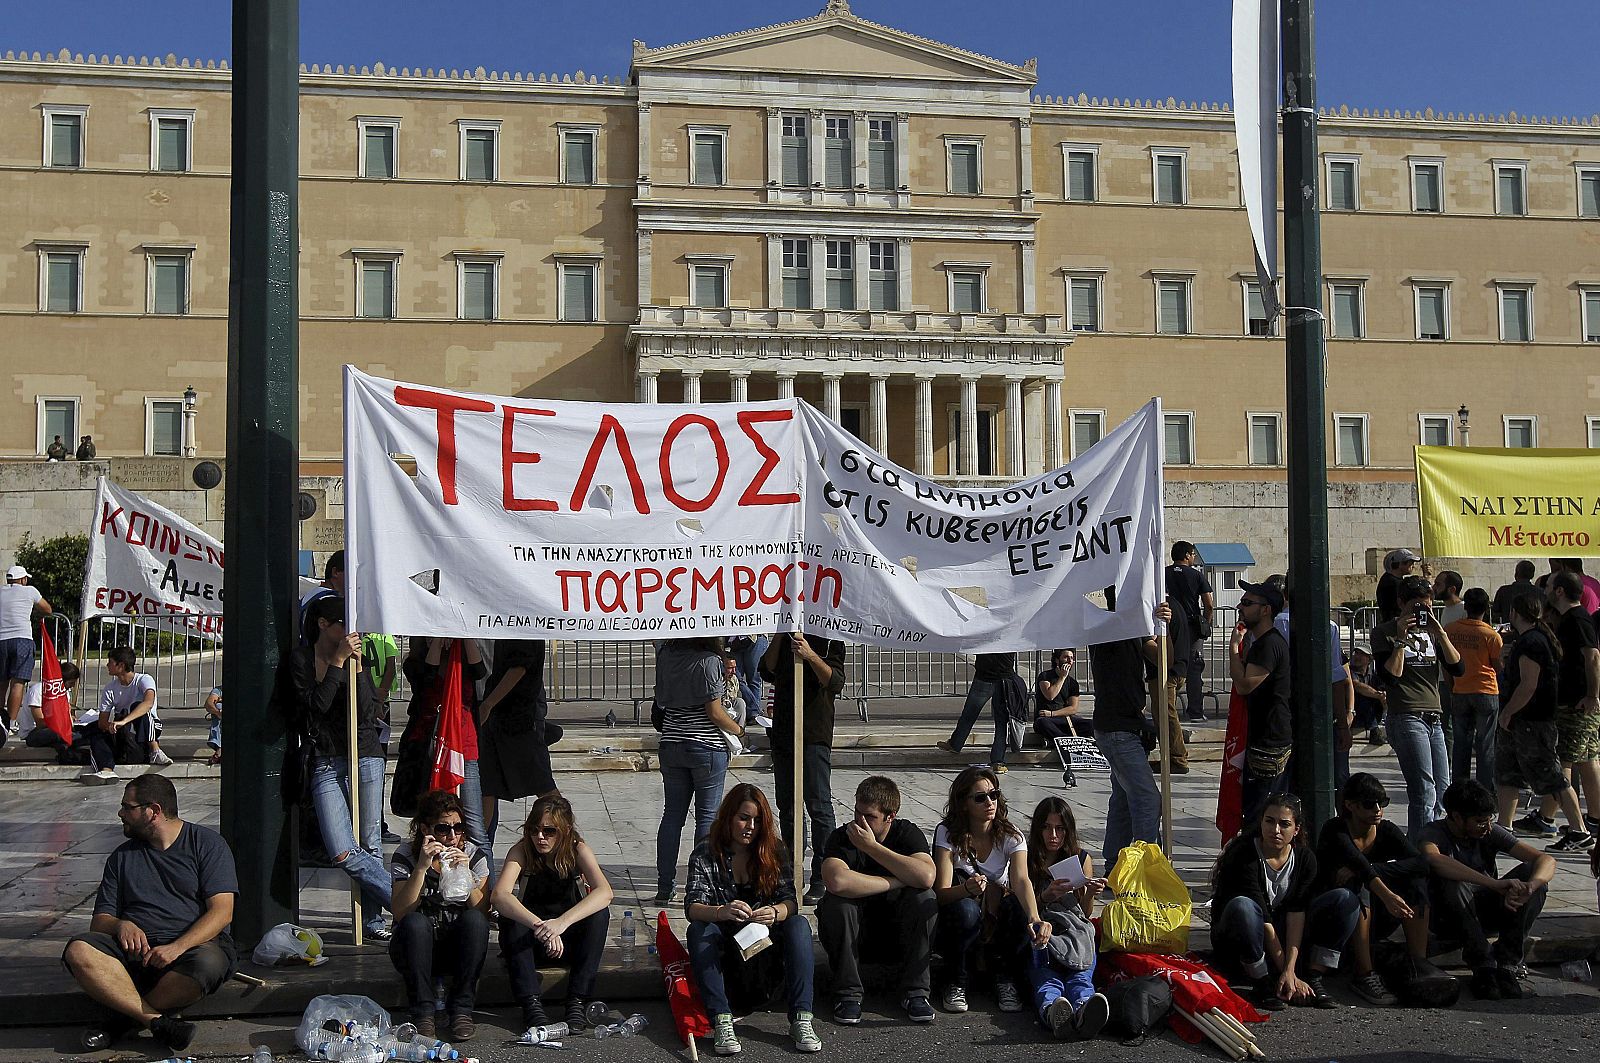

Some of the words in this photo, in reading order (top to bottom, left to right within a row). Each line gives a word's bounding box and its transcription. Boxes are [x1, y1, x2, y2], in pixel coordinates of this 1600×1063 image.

[394, 385, 801, 515] ΤΕΛΟΣ
[840, 449, 903, 491] στα
[1460, 496, 1505, 516] ΝΑΙ
[1513, 496, 1583, 516] ΣΤΗΝ
[1488, 525, 1590, 547] Μέτωπο
[513, 546, 536, 562] ΓΙΑ
[541, 546, 571, 561] ΤΗΝ
[576, 546, 692, 563] ΑΝΑΣΥΓΚΡΟΤΗΣΗ
[700, 544, 724, 558] ΤΗΣ
[729, 541, 823, 558] ΚΟΜΜΟΥΝΙΣΤΗΣ
[478, 615, 503, 628] ΓΙΑ
[507, 615, 531, 627] ΕΝΑ
[535, 615, 594, 631] ΜΕΤΩΠΟ
[598, 617, 664, 631] ΔΙΕΞΟΔΟΥ
[669, 616, 696, 630] ΑΠΟ
[702, 615, 725, 629] ΤΗΝ
[731, 613, 762, 628] ΚΡΙΣΗ
[773, 611, 795, 625] ΓΙΑ
[808, 613, 863, 635] ΟΡΓΑΝΩΣΗ
[873, 624, 893, 639] ΤΟΥ
[897, 629, 927, 642] ΛΑΟΥ
